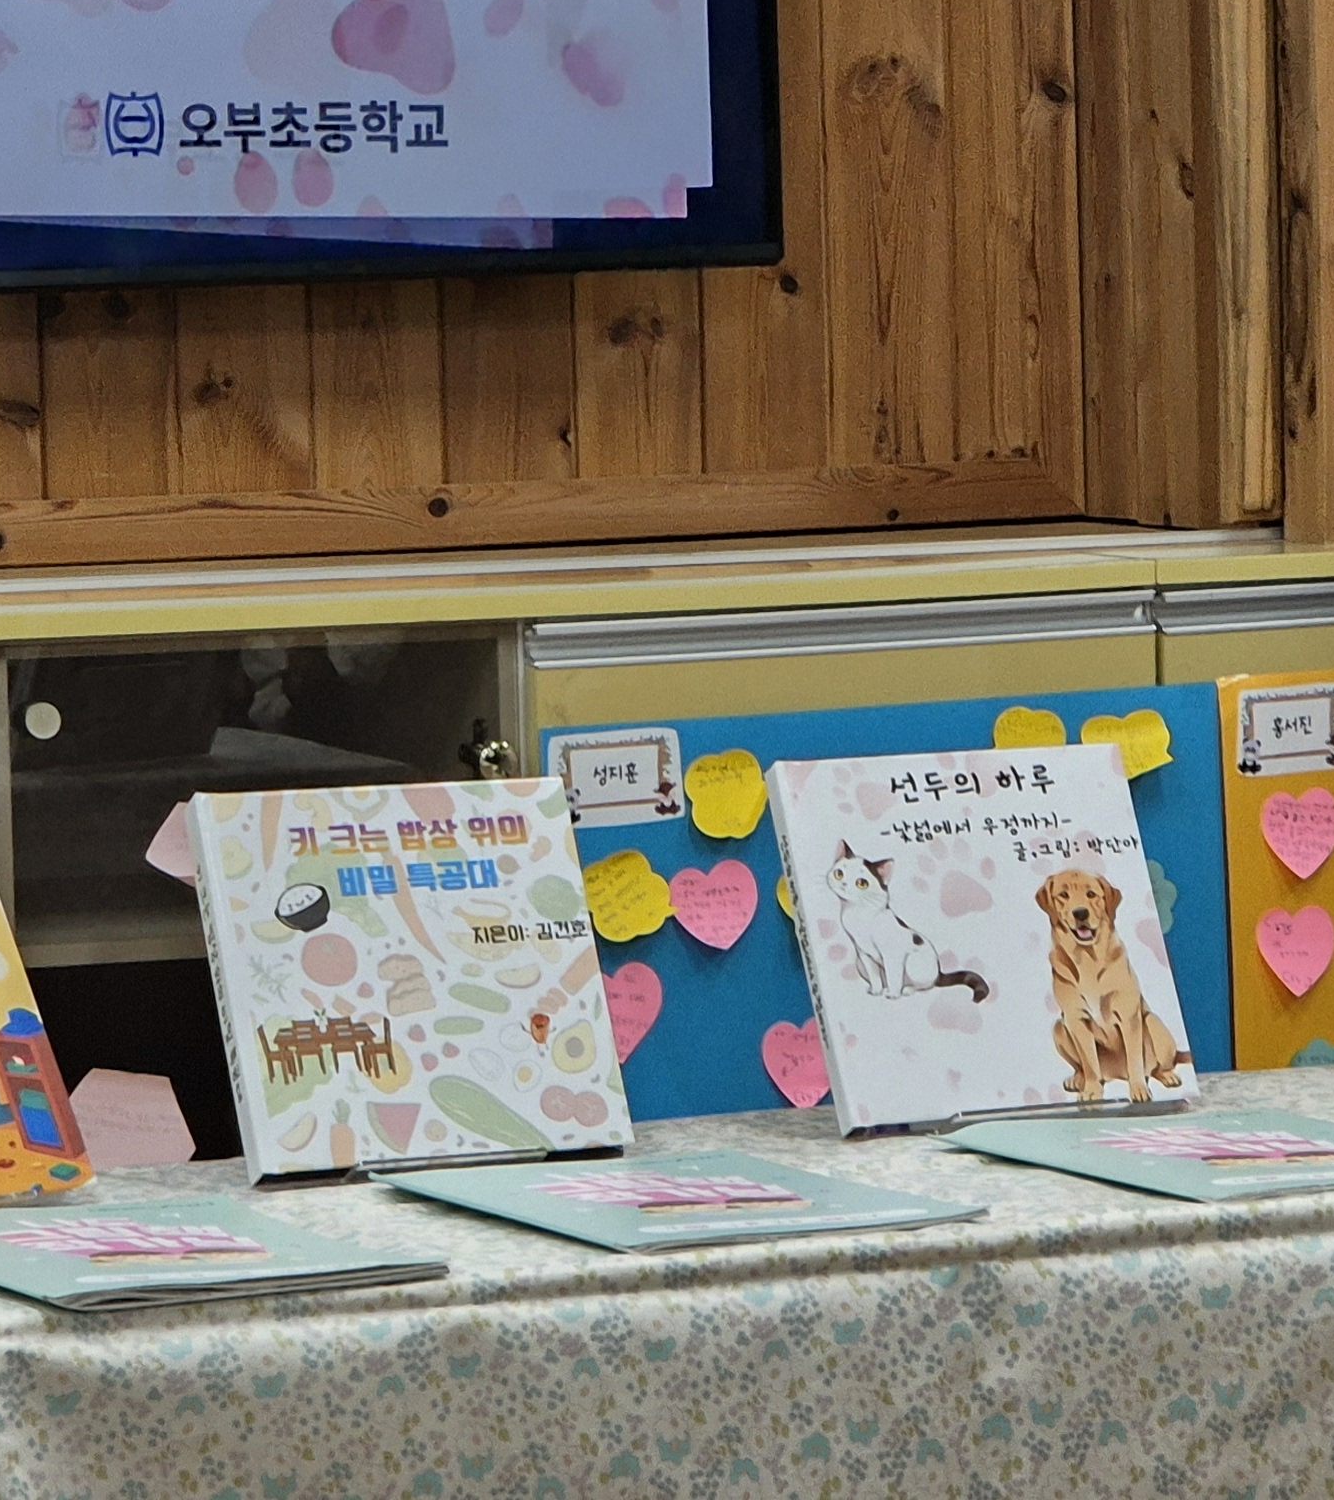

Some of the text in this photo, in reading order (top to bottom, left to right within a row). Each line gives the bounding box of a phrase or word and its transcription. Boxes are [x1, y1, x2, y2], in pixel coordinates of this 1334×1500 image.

[178, 99, 450, 155] 오부초등학교
[1272, 715, 1313, 740] 홍서진
[889, 763, 1056, 804] 선두의 하루
[288, 814, 530, 857] 키 크는 밥상 위의
[982, 811, 1073, 837] 우정까지-
[1087, 835, 1139, 855] 박단아
[336, 858, 500, 898] 비밀 특공대
[471, 924, 530, 944] 지은이:
